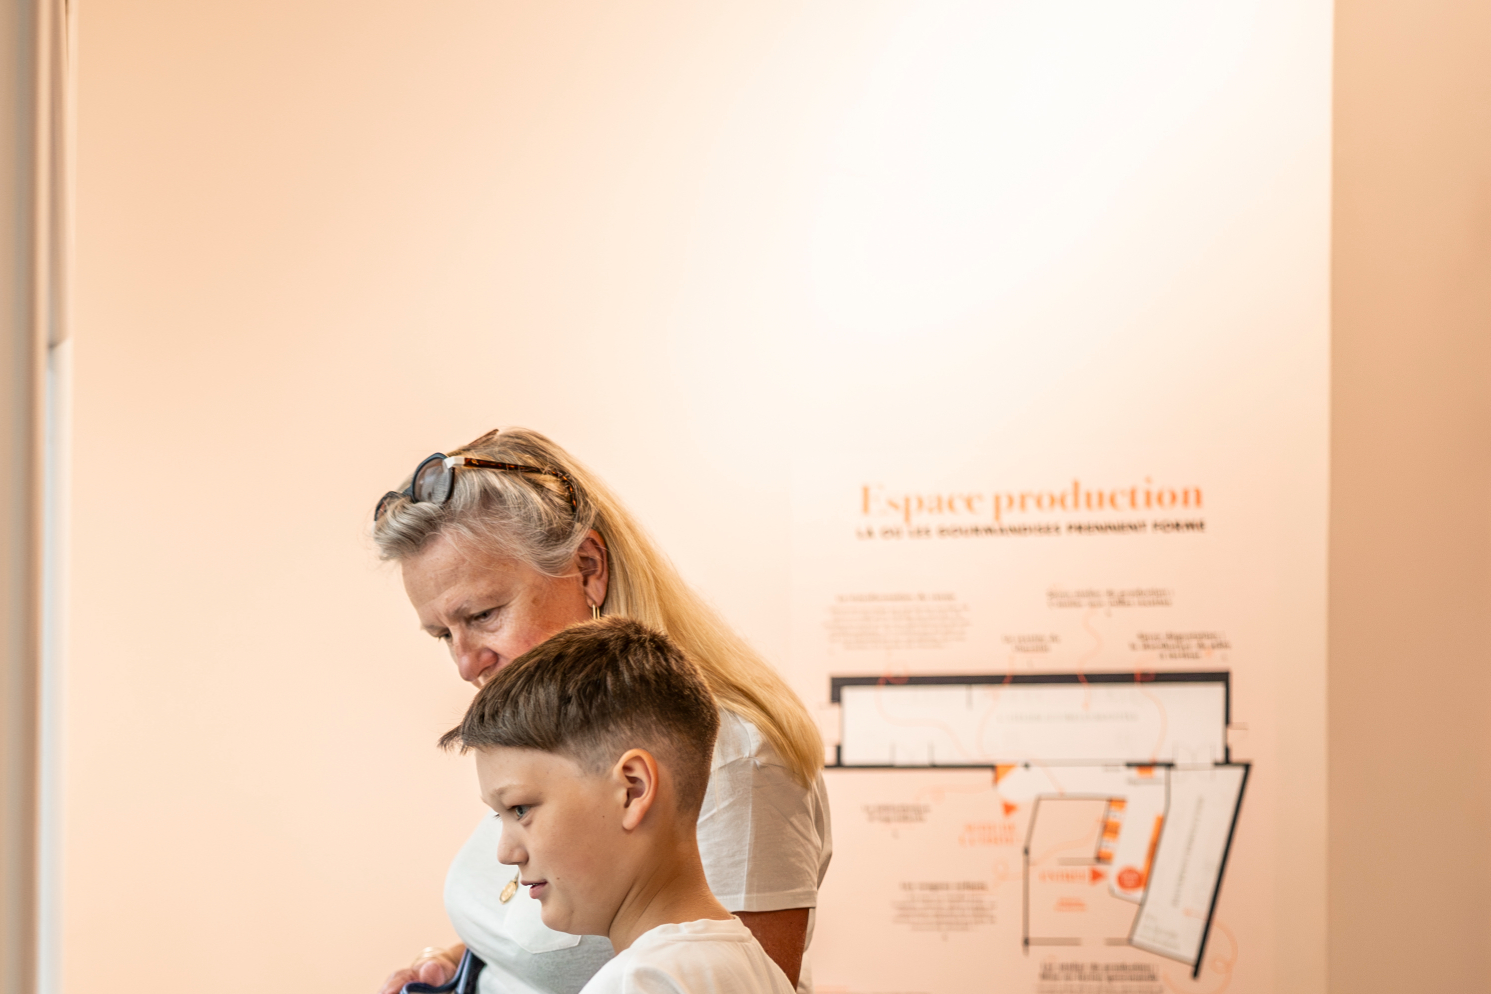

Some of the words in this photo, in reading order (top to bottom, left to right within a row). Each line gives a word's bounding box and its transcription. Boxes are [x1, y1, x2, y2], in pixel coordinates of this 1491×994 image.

[861, 484, 984, 523] Espace
[993, 477, 1203, 521] production
[1152, 517, 1206, 535] FORME
